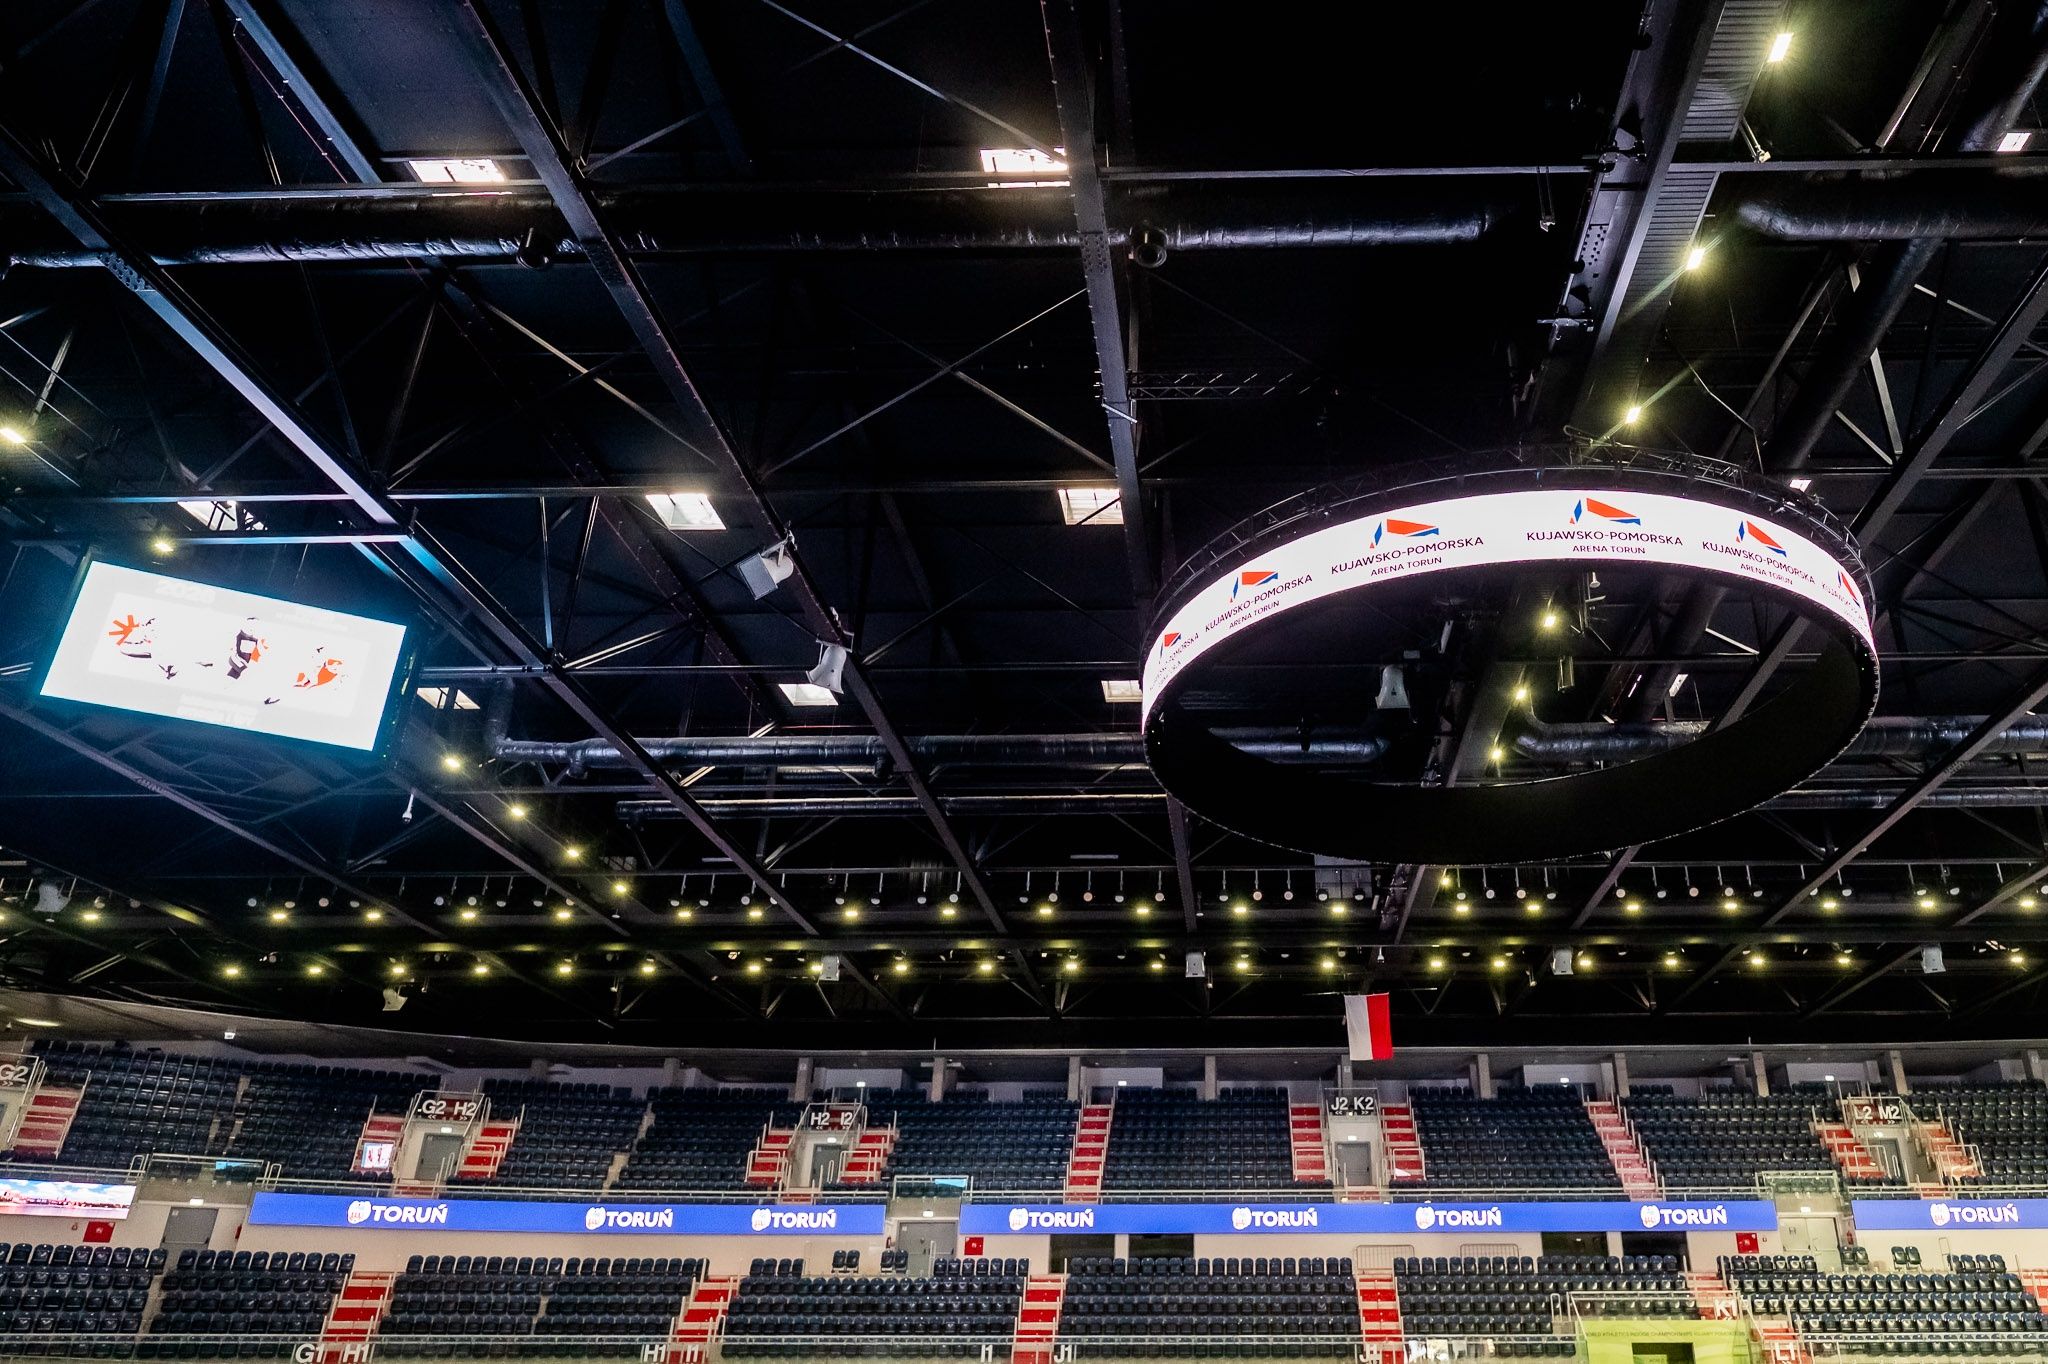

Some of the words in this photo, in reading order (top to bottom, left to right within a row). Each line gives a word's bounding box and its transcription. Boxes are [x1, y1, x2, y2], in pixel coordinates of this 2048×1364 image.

[1527, 530, 1683, 546] KUJAWSKO-POMORSKA
[1331, 536, 1484, 575] KUJAWSKO-POMORSKA
[1573, 545, 1608, 553] ARENA
[1371, 563, 1404, 577] ARENA
[1702, 541, 1816, 585] KUJAWSKO-POMORSKA
[1740, 563, 1767, 577] ARENA
[1204, 574, 1313, 633] KUJAWSKO-POMORSKA
[1228, 612, 1253, 630] ARENA
[0, 1063, 29, 1083] G2
[422, 1100, 447, 1115] G2
[454, 1101, 477, 1116] H2
[1331, 1096, 1348, 1110] J2
[1353, 1096, 1374, 1110] K2
[1854, 1105, 1874, 1120] L2
[1878, 1105, 1903, 1120] M2
[810, 1112, 830, 1126] H2
[372, 1204, 449, 1224] TORUŃ
[604, 1208, 674, 1228] TORUŃ
[770, 1209, 838, 1229] TORUŃ
[1028, 1208, 1095, 1228] TORUŃ
[1250, 1207, 1318, 1228] TORUŃ
[1434, 1207, 1502, 1227] TORUŃ
[1660, 1204, 1728, 1225] TORUŃ
[1950, 1203, 2019, 1223] TORUŃ
[1714, 1298, 1738, 1317] K1
[295, 1343, 325, 1363] G1
[342, 1343, 370, 1363] H1
[643, 1344, 667, 1363] H1
[1053, 1344, 1073, 1363] J1
[1774, 1340, 1796, 1361] L1
